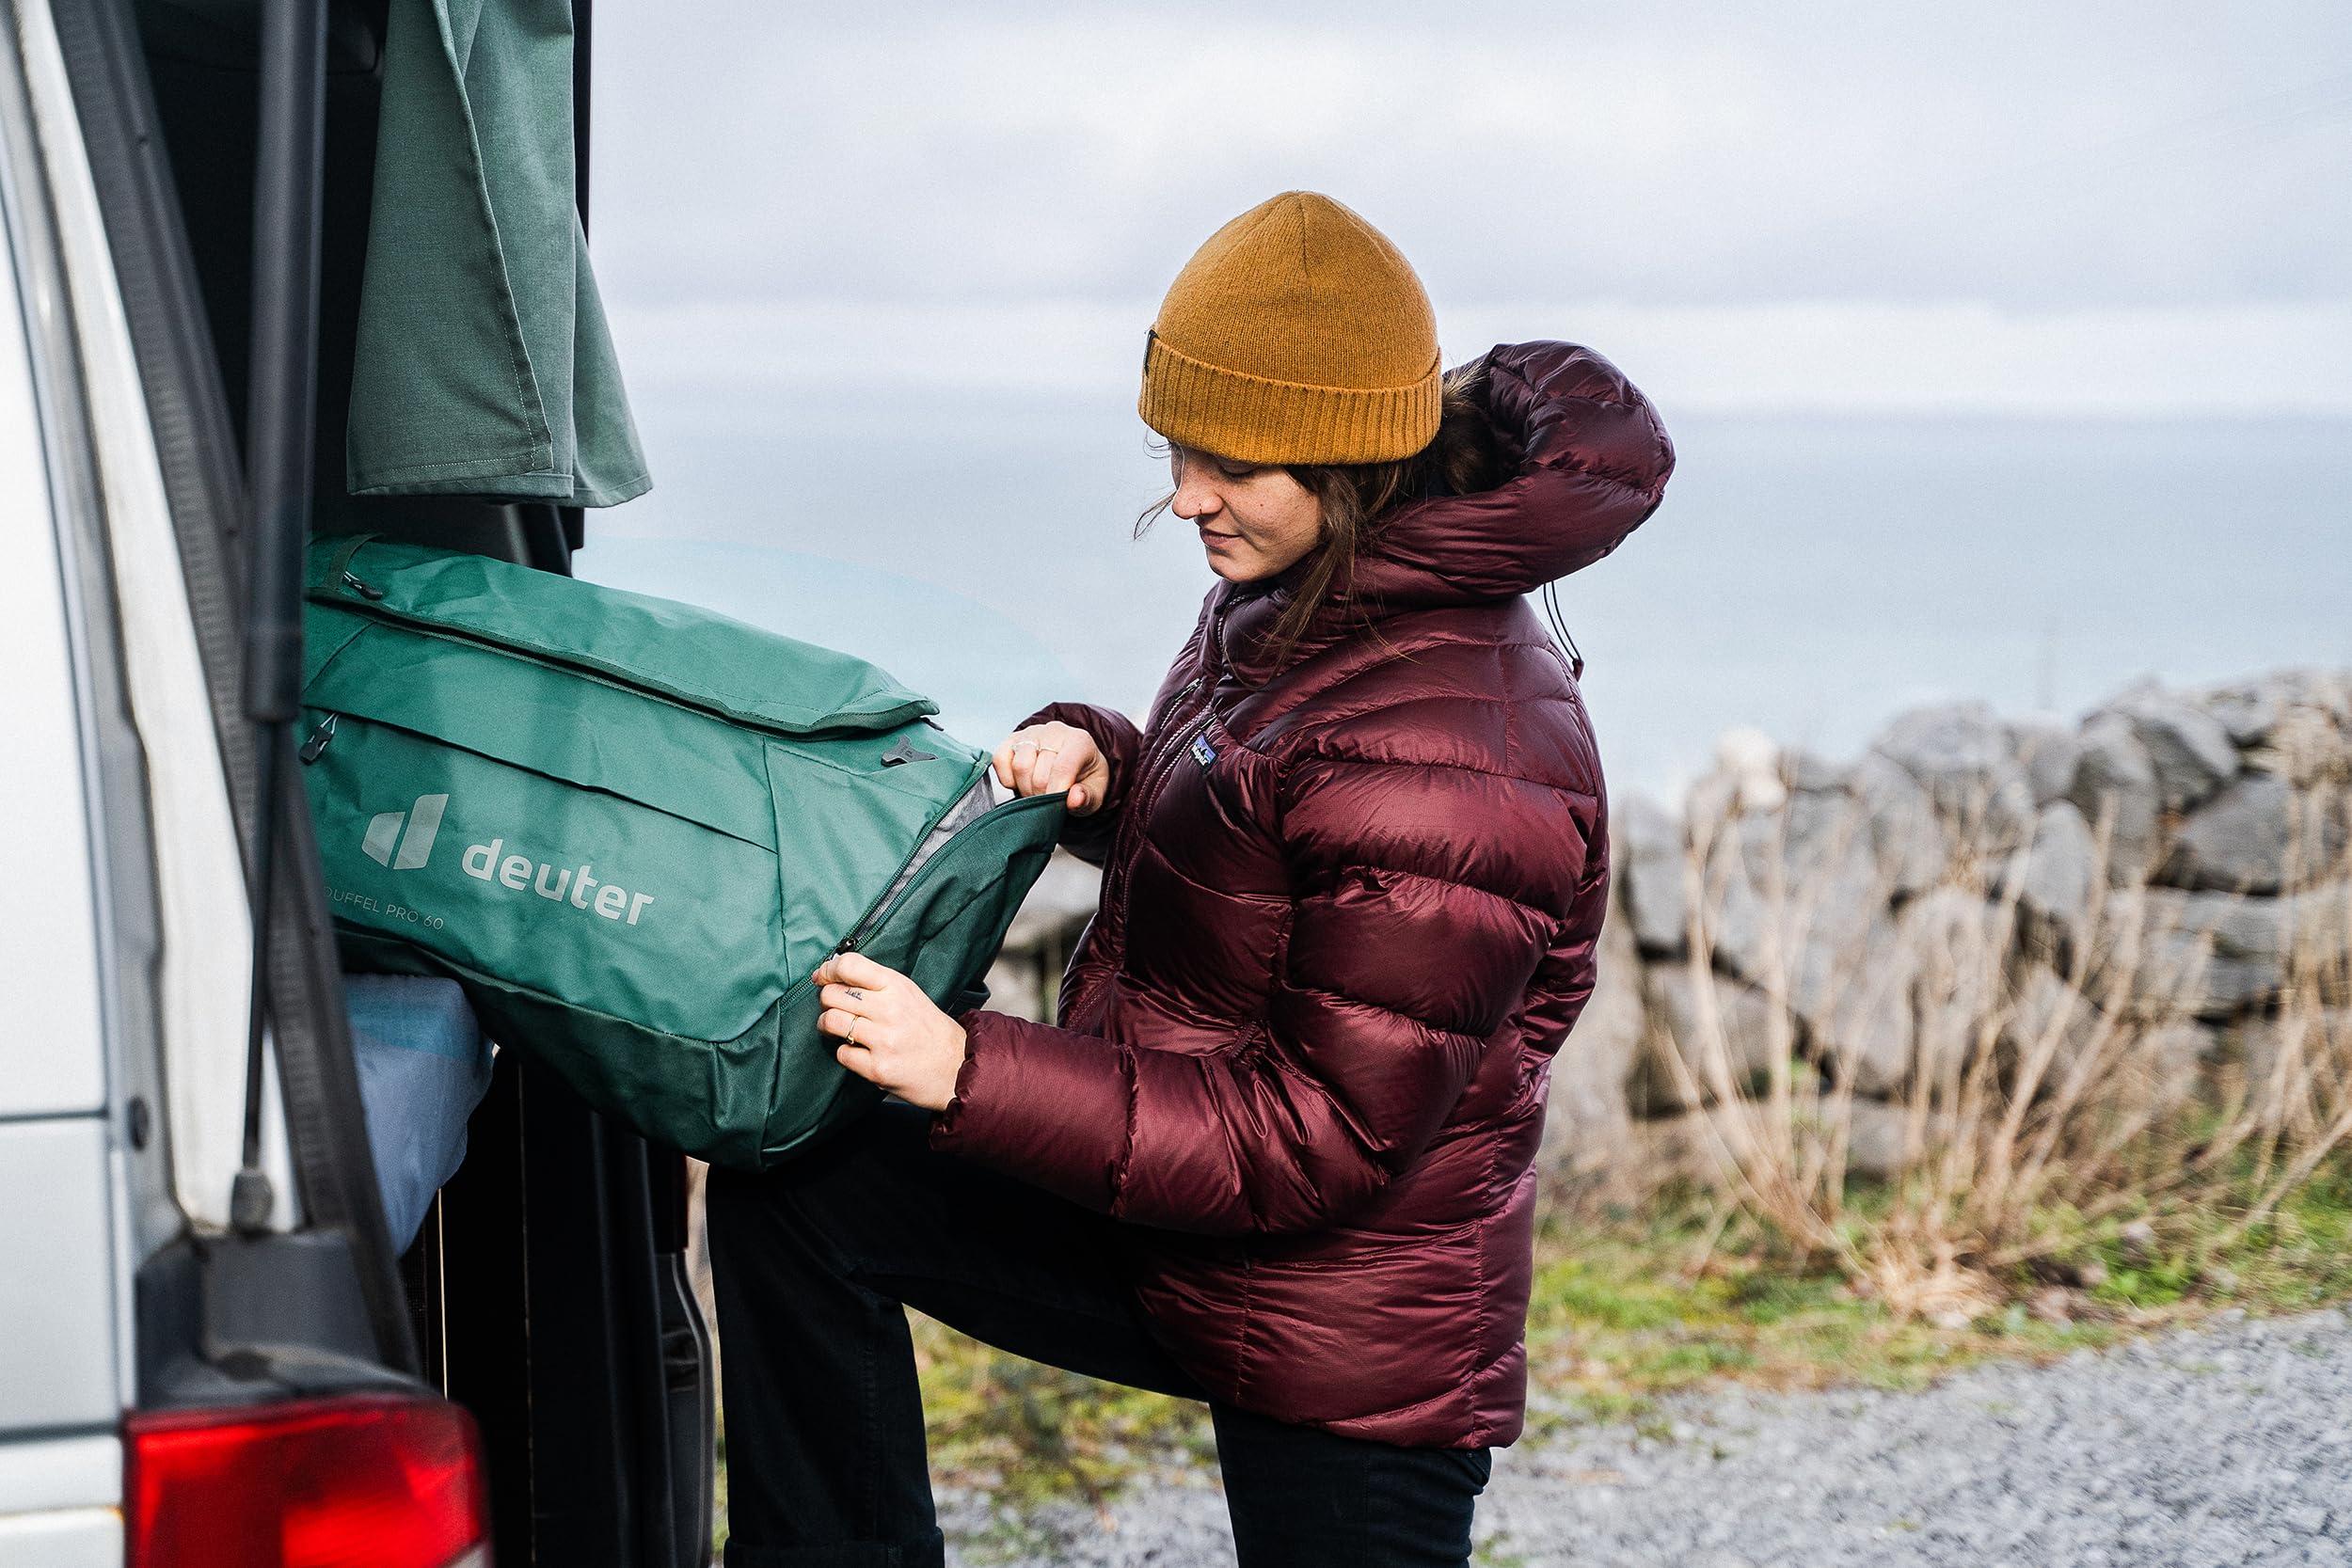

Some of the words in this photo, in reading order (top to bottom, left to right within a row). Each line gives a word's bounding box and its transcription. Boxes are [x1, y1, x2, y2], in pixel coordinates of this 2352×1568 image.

[461, 838, 656, 927] deuter
[385, 904, 420, 923] PRO
[422, 914, 445, 930] 60
